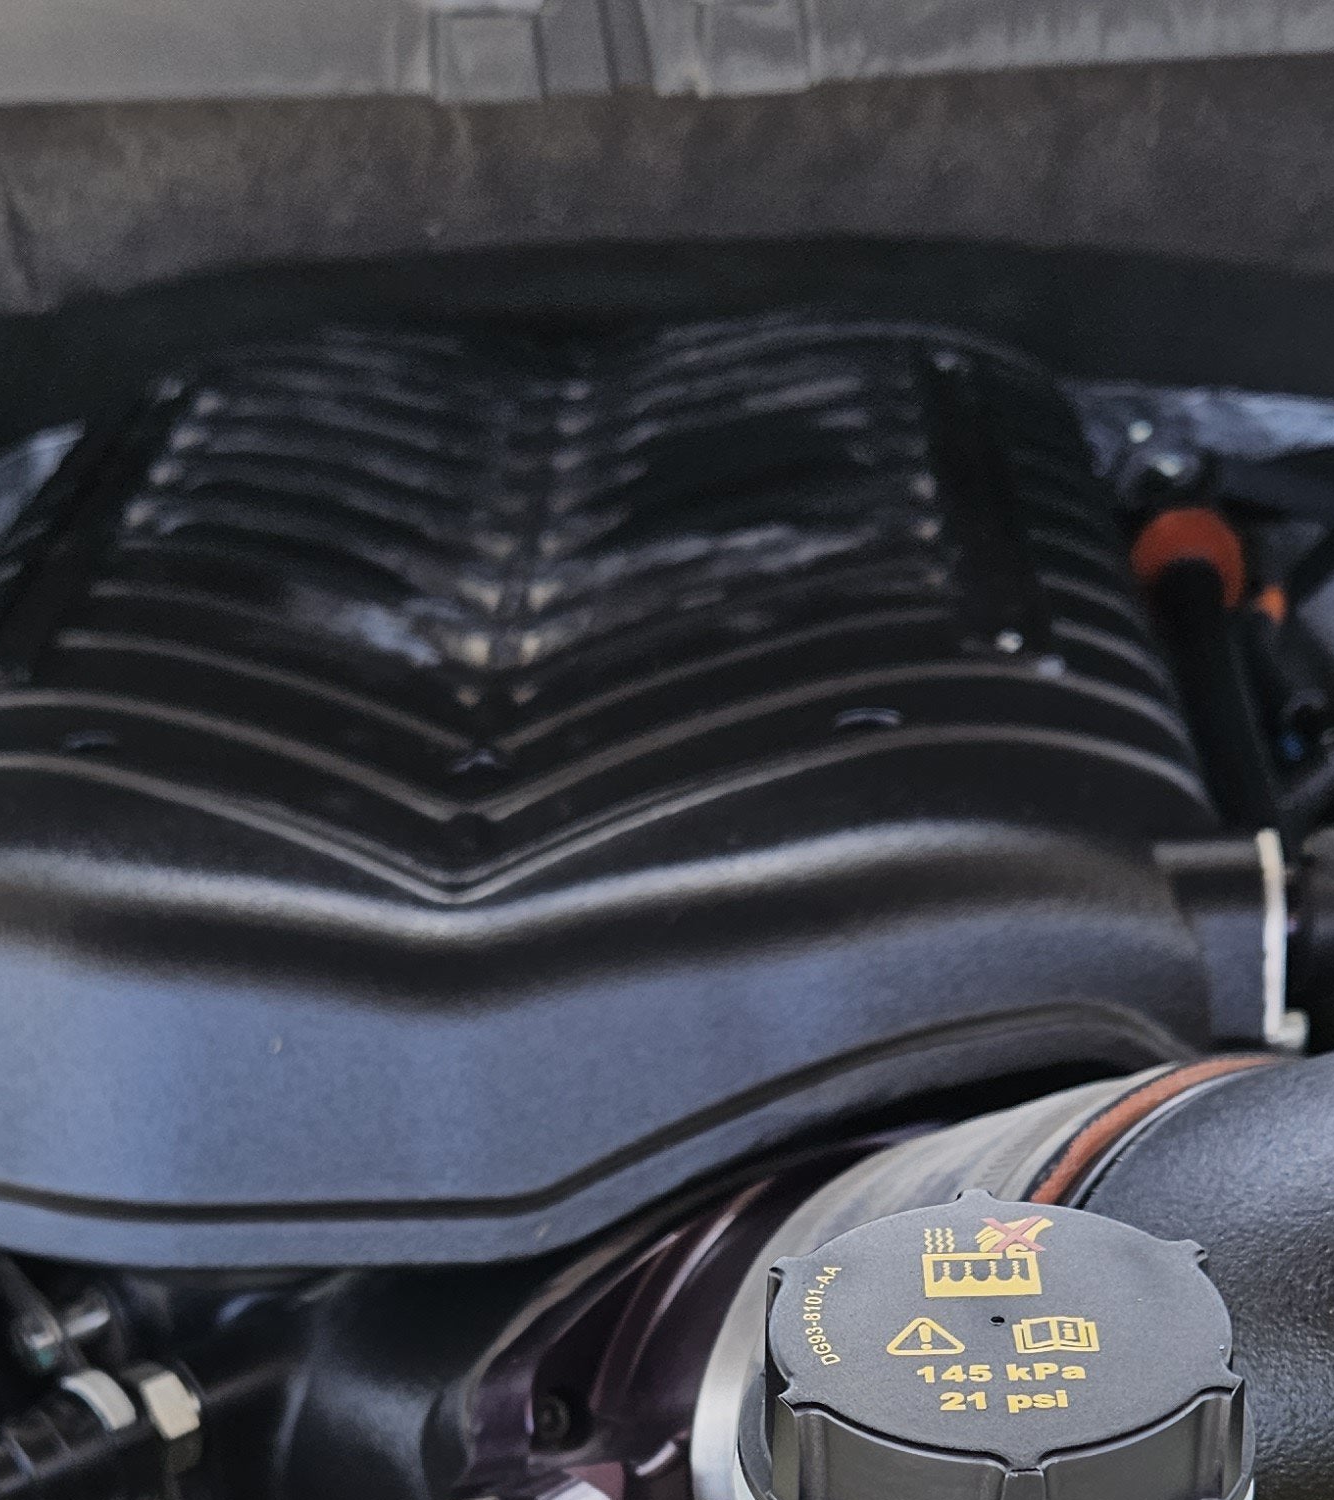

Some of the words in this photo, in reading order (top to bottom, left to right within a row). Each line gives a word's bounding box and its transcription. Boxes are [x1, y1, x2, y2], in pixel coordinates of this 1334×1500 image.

[802, 1265, 842, 1366] DG93-8101-AA
[916, 1364, 992, 1383] 145
[1006, 1362, 1086, 1381] kPa
[939, 1391, 987, 1411] 21
[1006, 1390, 1069, 1413] psi
